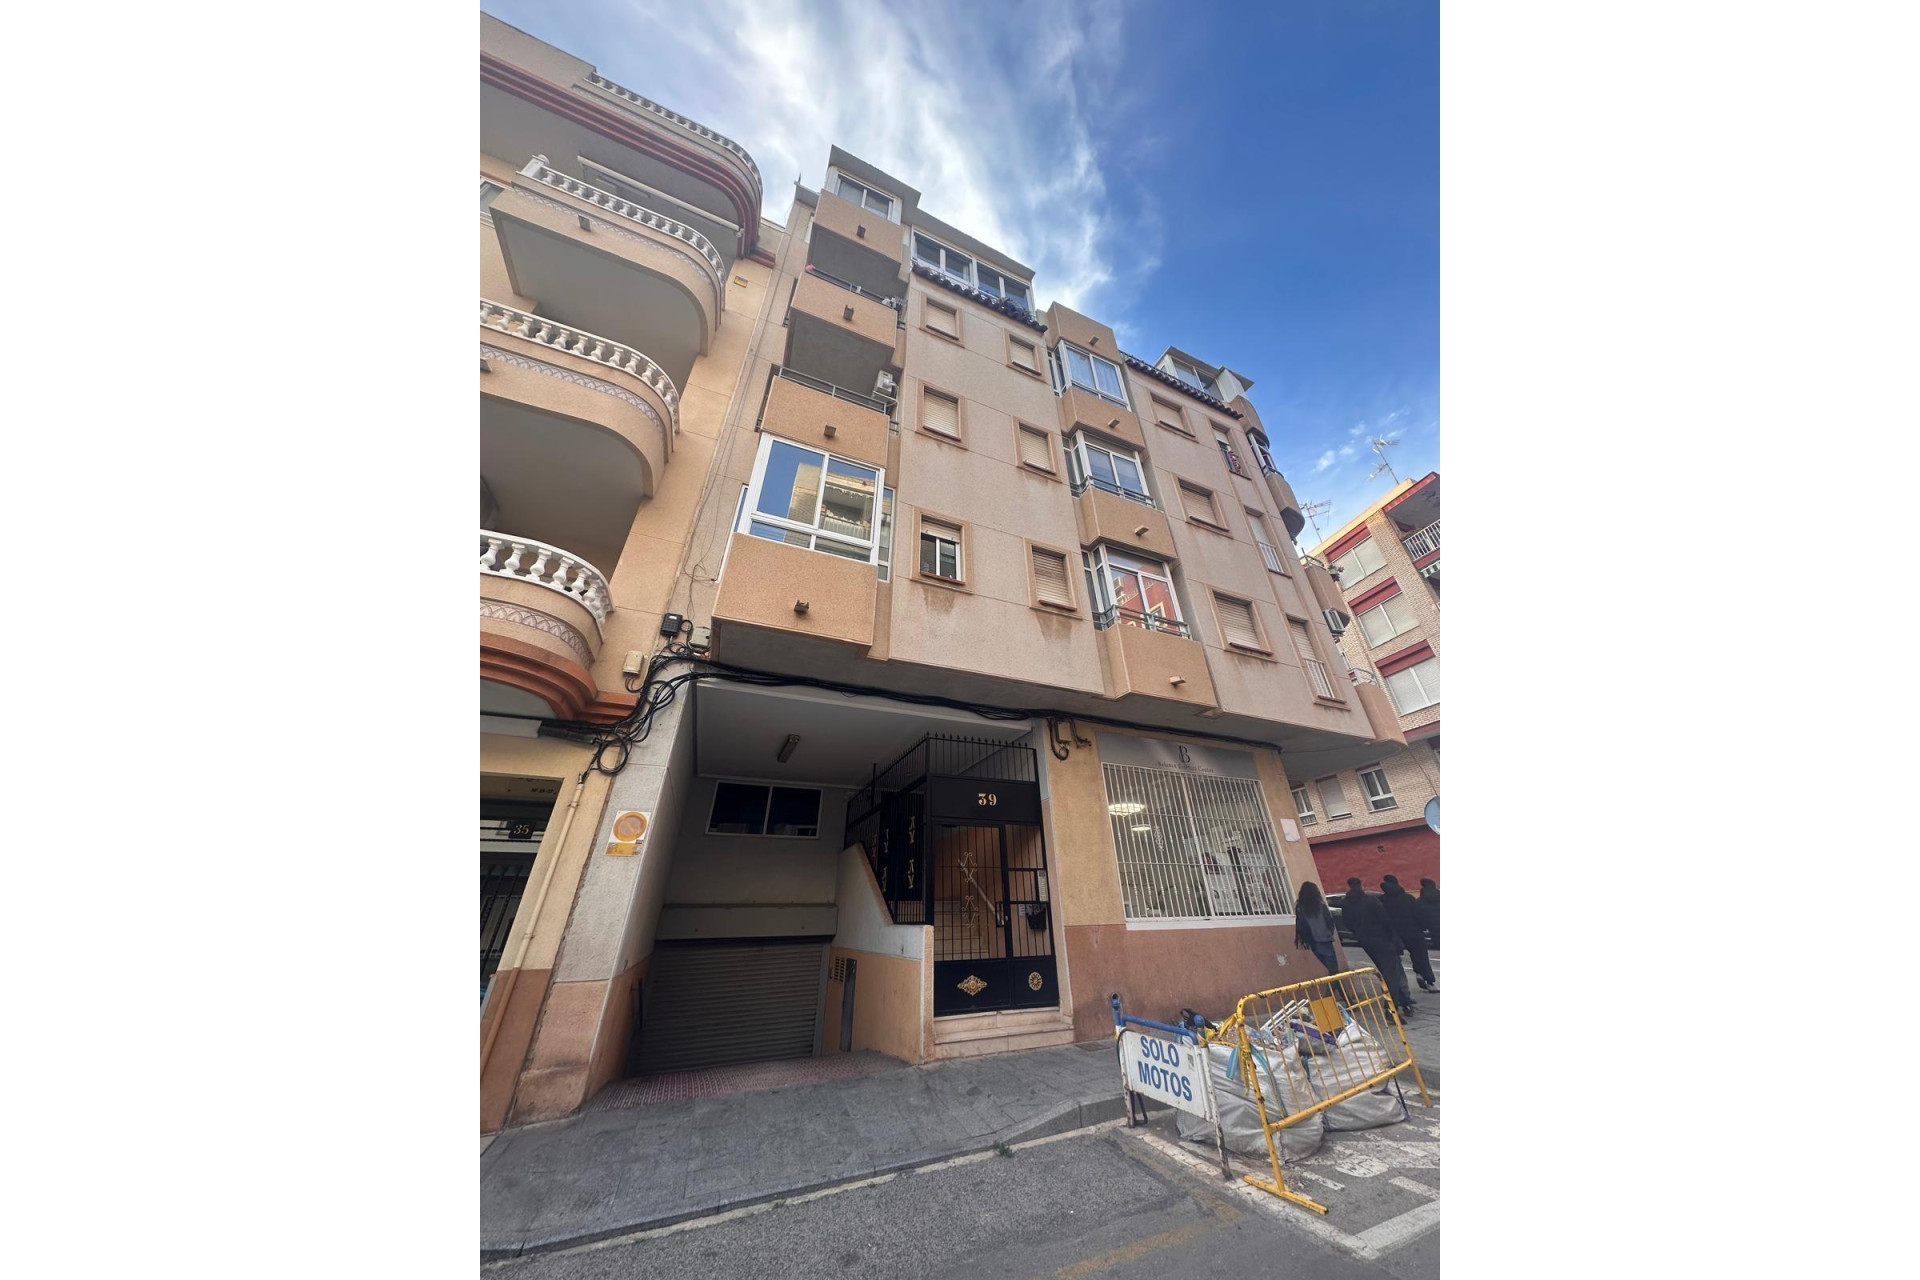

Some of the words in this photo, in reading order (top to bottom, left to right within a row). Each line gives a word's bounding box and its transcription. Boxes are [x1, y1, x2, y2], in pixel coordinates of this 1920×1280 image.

[978, 793, 997, 806] 39
[513, 824, 530, 835] 35
[1140, 1035, 1180, 1068] SOLO
[1138, 1060, 1193, 1102] MOTOS
